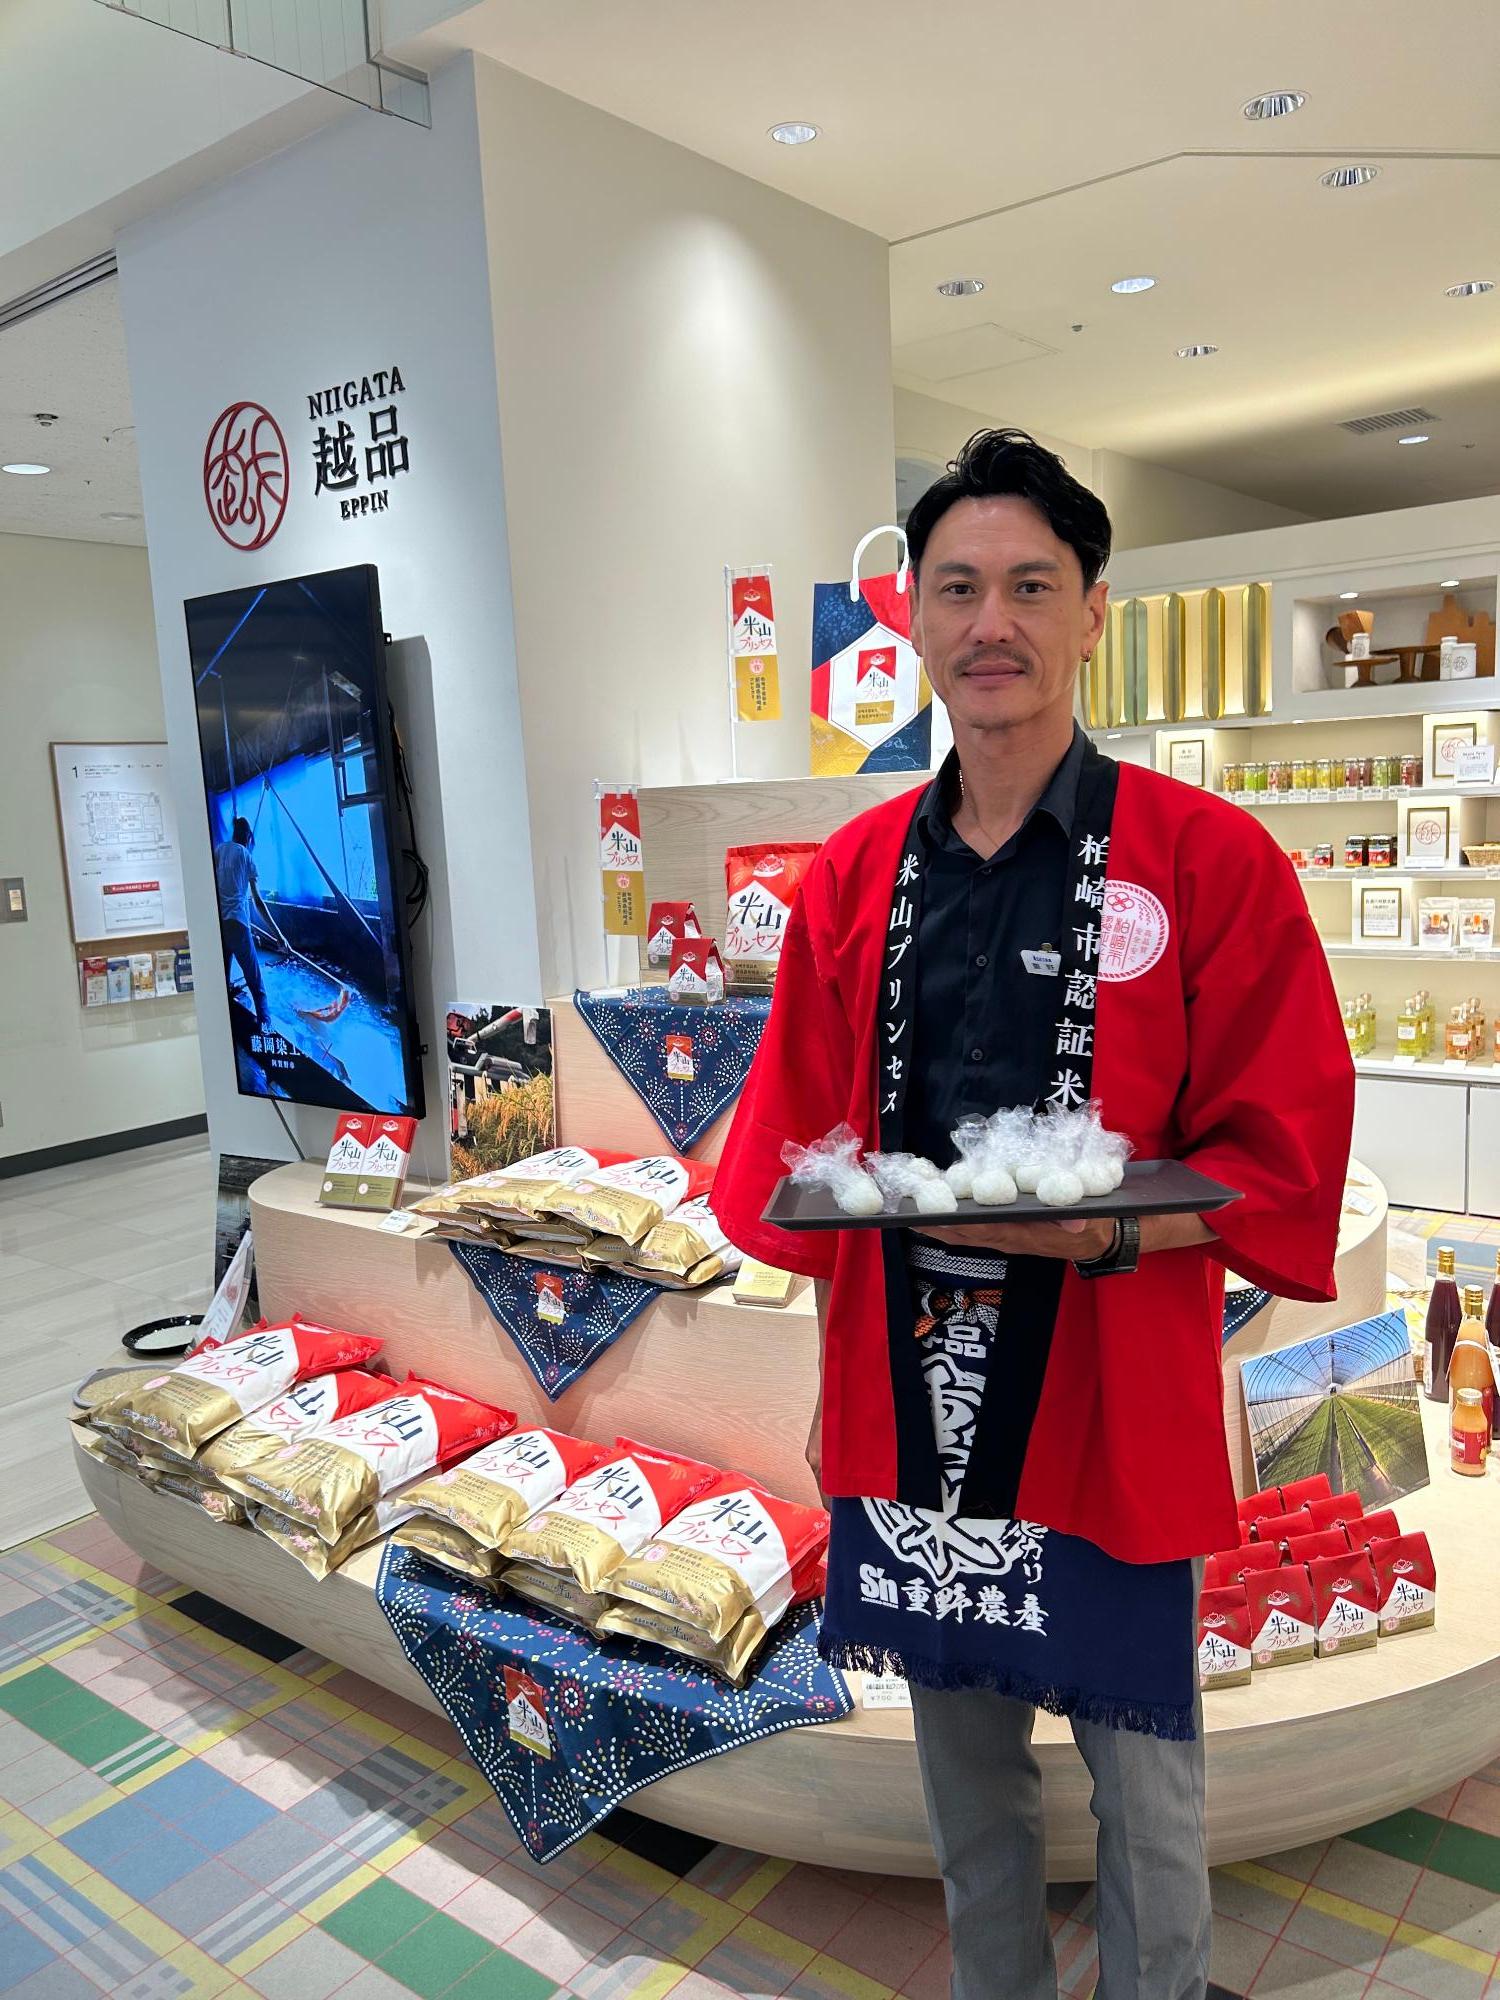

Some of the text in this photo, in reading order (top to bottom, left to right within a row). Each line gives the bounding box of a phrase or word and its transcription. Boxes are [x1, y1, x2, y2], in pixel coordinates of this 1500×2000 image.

[306, 366, 406, 420] NIIGATA
[312, 404, 410, 497] 越品
[340, 489, 389, 520] EPPIN
[737, 616, 772, 637] 米山
[740, 636, 774, 652] プリンセス
[864, 671, 889, 688] 米山
[607, 831, 638, 853] 米山
[607, 851, 640, 868] プリンセス
[728, 891, 782, 930] 米山
[725, 926, 782, 956] プリンセス
[676, 966, 696, 983] 米山
[880, 852, 920, 1115] 米山プリンセス
[1044, 833, 1111, 1106] 柏崎市認証米
[333, 1140, 361, 1159] 米山
[367, 1141, 398, 1162] 米山
[330, 1157, 361, 1171] プリンセス
[367, 1159, 397, 1174] プリンセス
[628, 1158, 679, 1185] 米山
[220, 1335, 285, 1367] 米山
[190, 1353, 258, 1386] プリンセス
[354, 1398, 424, 1442] 米山
[328, 1417, 401, 1458] プリンセス
[486, 1435, 551, 1470] 米山
[472, 1455, 536, 1485] プリンセス
[578, 1466, 644, 1510] 米山
[561, 1491, 628, 1531] プリンセス
[686, 1498, 768, 1545] 米山
[667, 1520, 752, 1565] プリンセス
[900, 1577, 1050, 1637] 重野農産
[1394, 1583, 1424, 1606] 米山
[1329, 1602, 1364, 1624] 米山
[1394, 1602, 1425, 1617] プリンセス
[1264, 1615, 1300, 1637] 米山
[1331, 1622, 1366, 1637] プリンセス
[1199, 1637, 1236, 1660] 米山
[1266, 1635, 1301, 1650] プリンセス
[1201, 1658, 1238, 1673] プリンセス
[514, 1698, 543, 1731] 米山
